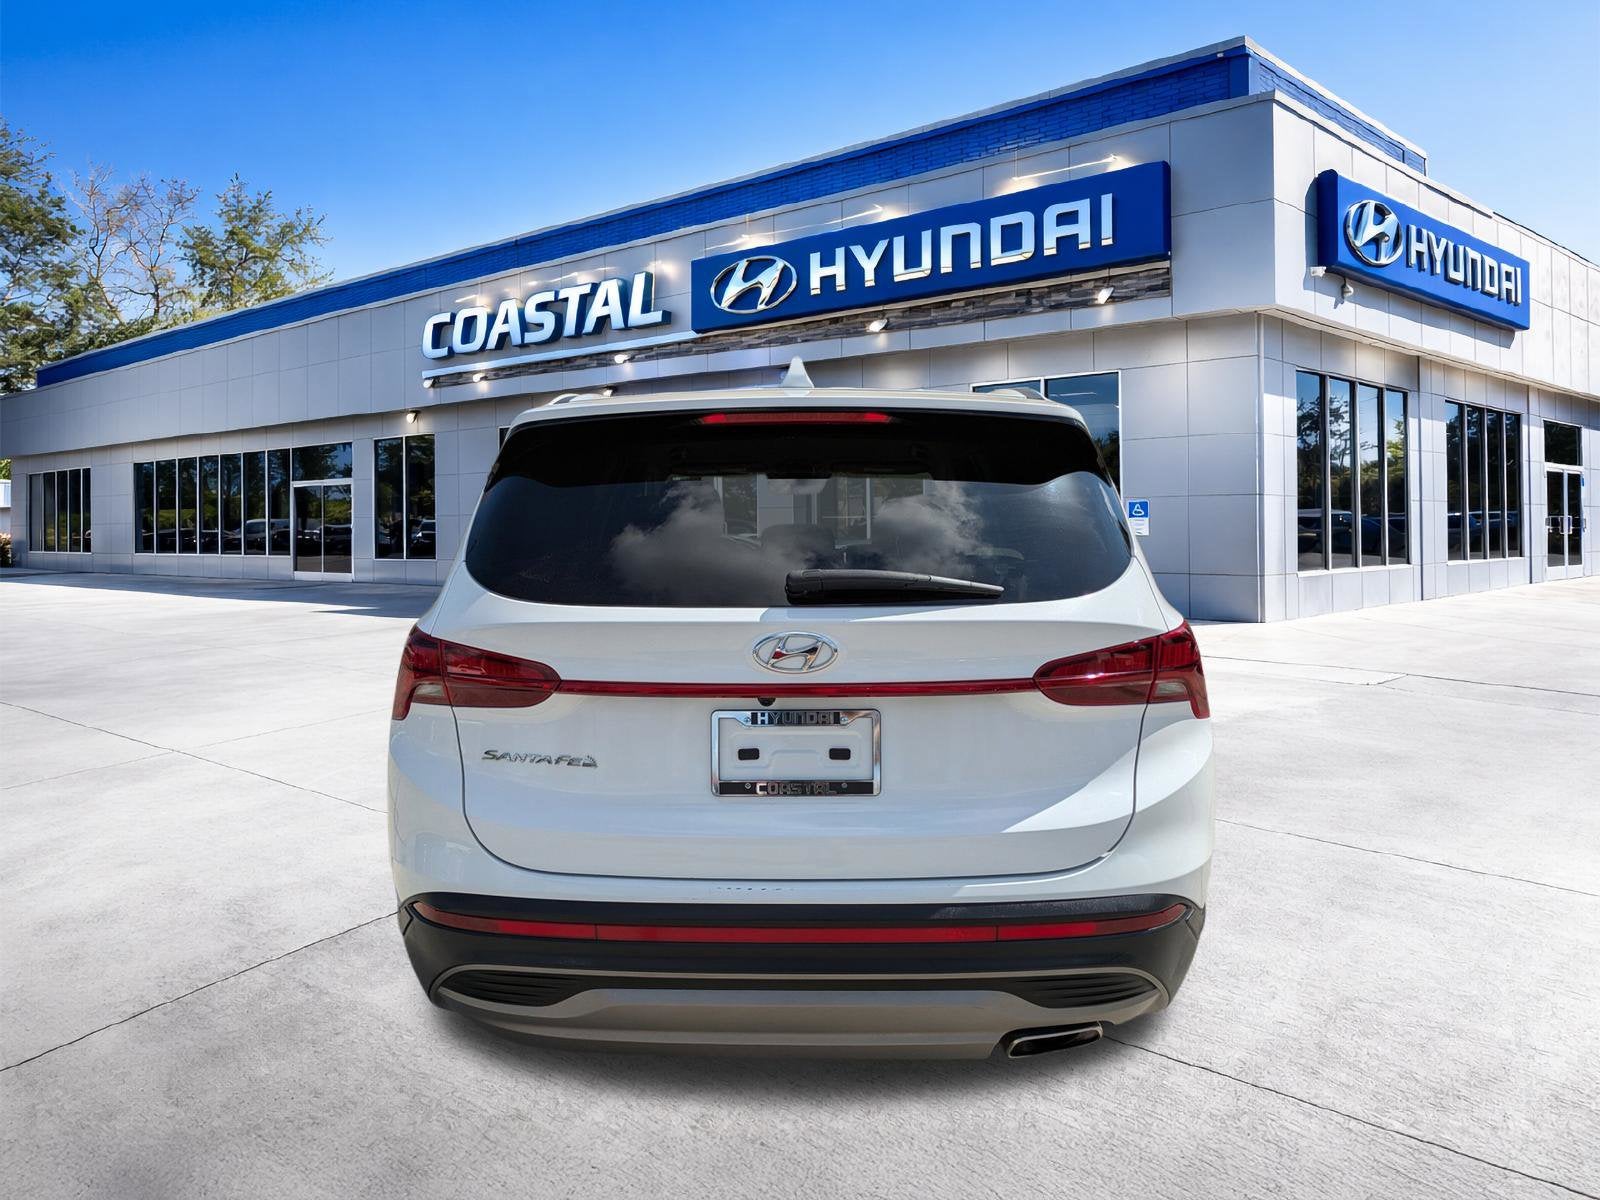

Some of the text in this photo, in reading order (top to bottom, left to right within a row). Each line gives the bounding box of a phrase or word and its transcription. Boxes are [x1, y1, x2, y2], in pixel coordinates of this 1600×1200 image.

[809, 193, 1114, 296] HYUNDAI
[1406, 223, 1523, 306] HYUNDAI
[422, 271, 670, 359] COASTAL
[756, 711, 836, 725] HYUNDAI
[755, 782, 838, 795] COASTAL
